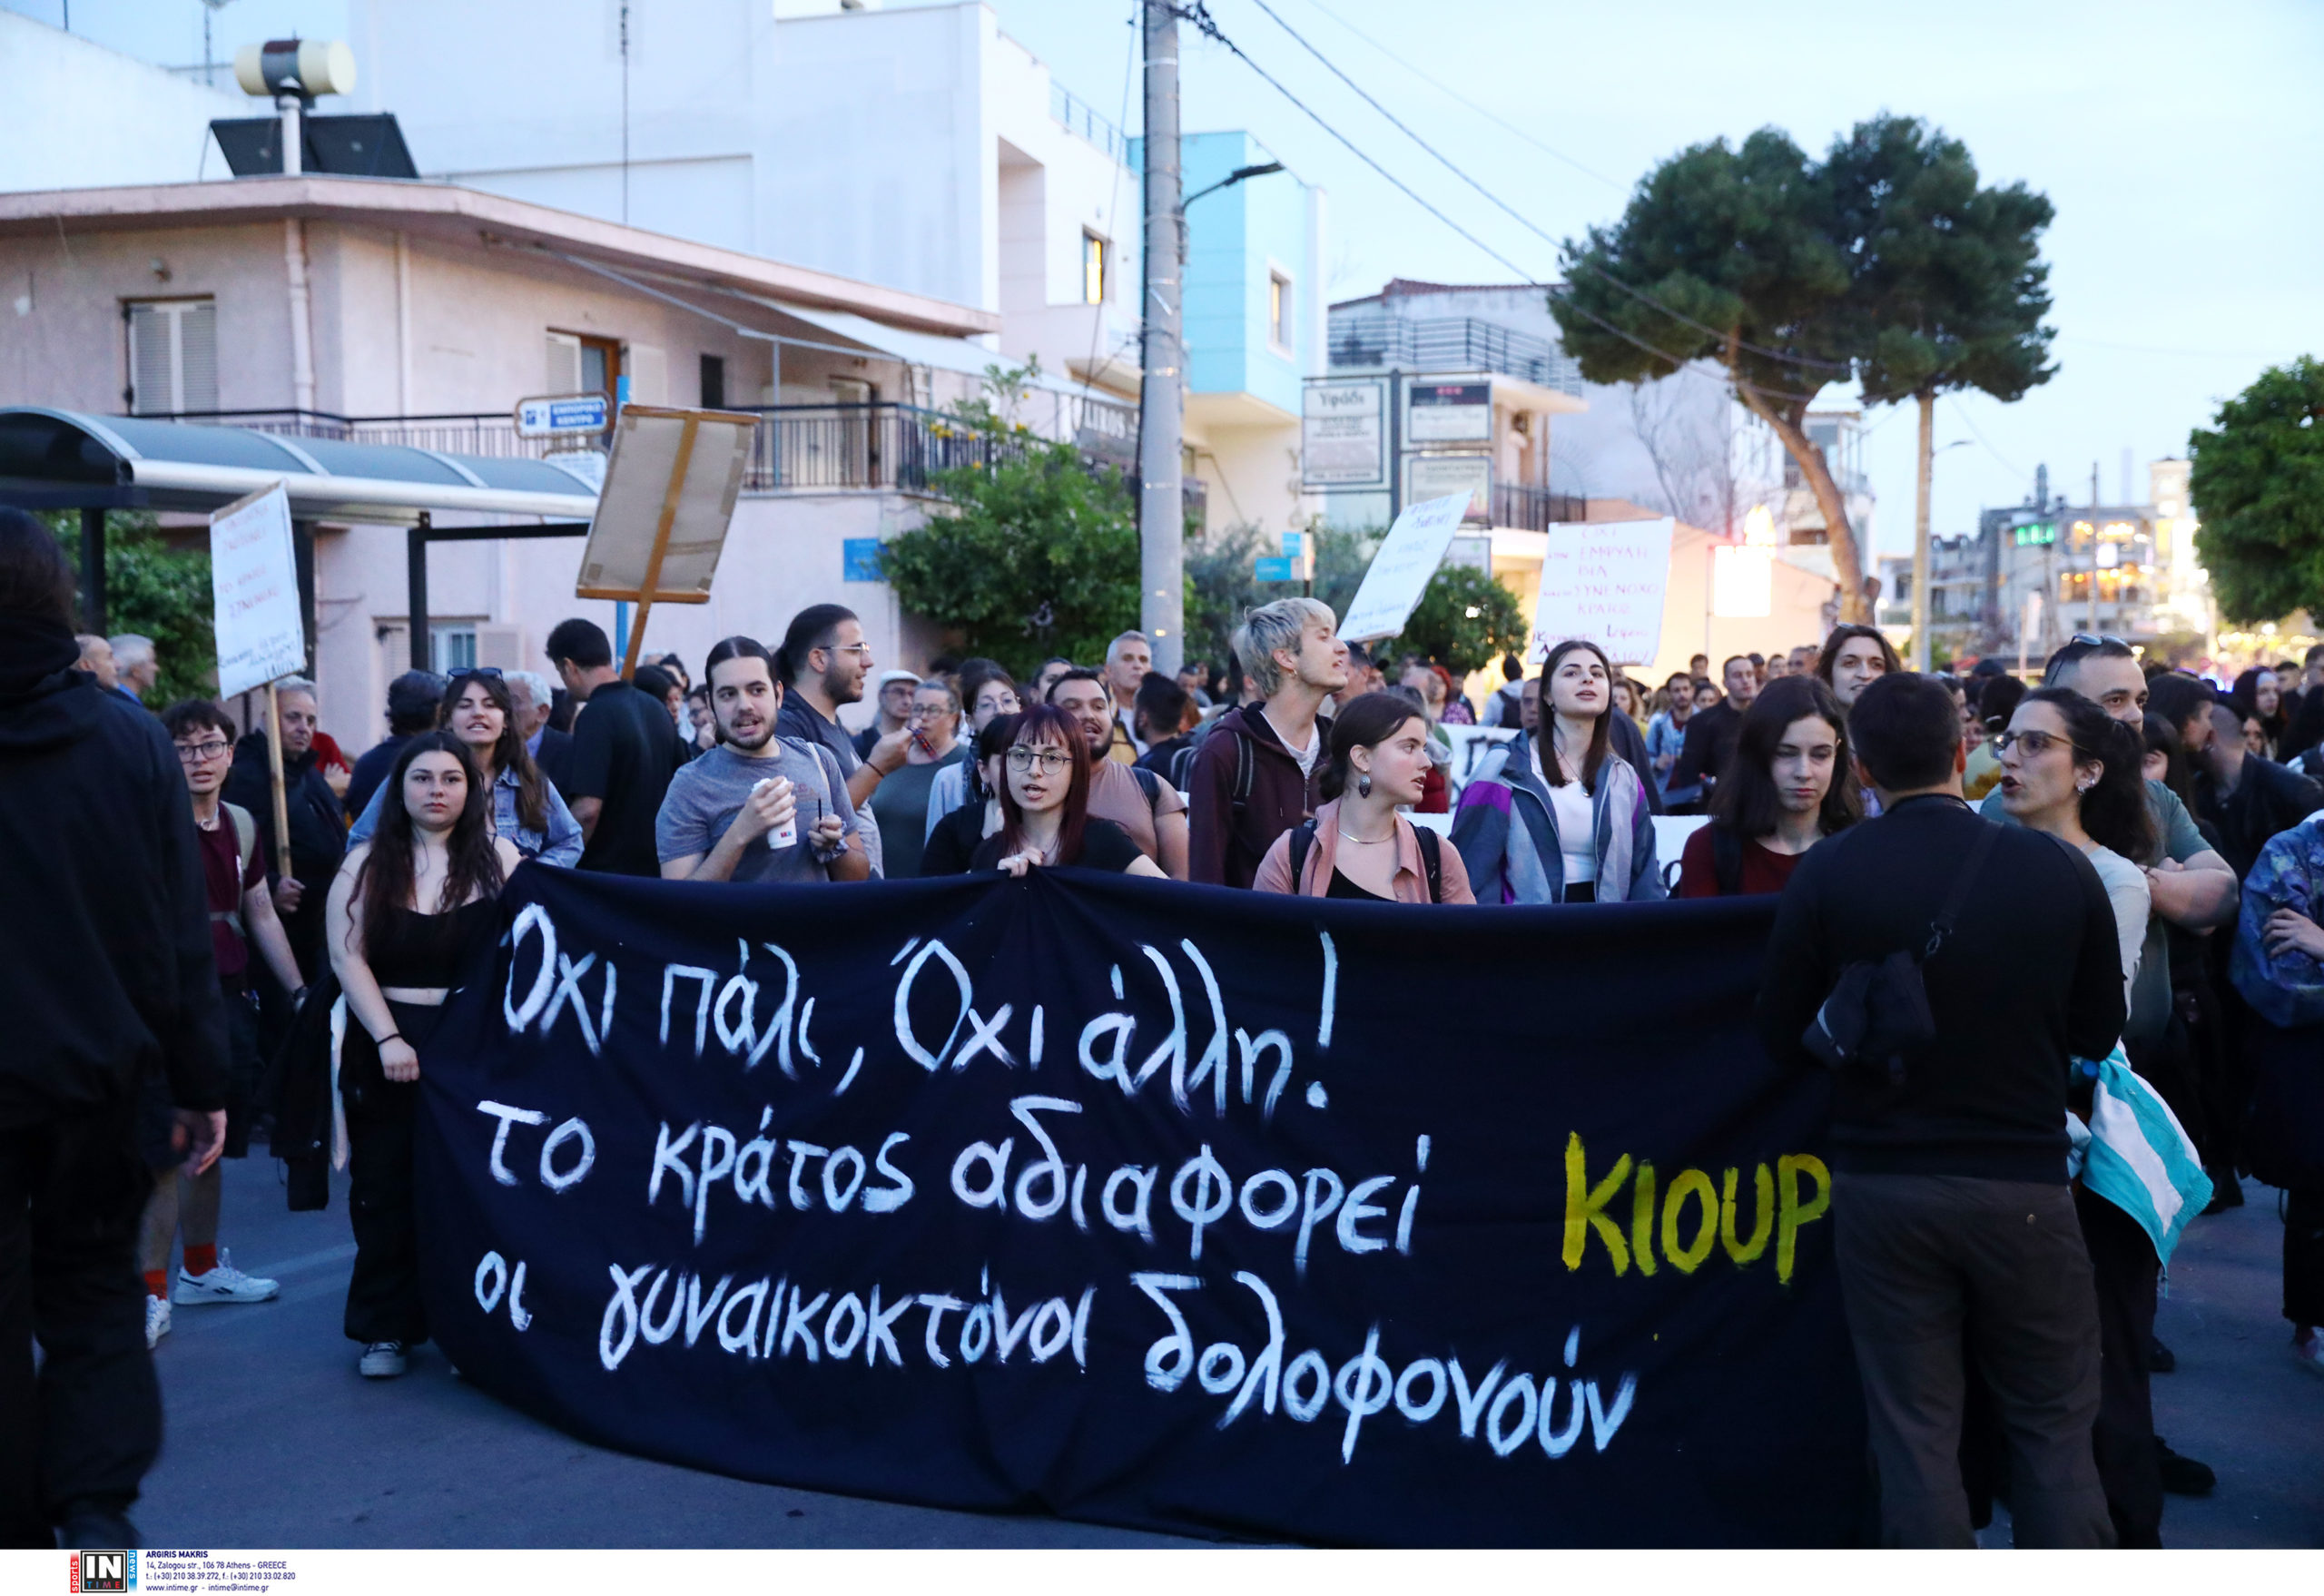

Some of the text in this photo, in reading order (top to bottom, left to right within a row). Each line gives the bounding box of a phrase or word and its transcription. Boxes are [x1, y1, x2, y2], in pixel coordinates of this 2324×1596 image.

[499, 901, 617, 1058] Όχι
[890, 939, 1044, 1072] Όχι
[1070, 933, 1338, 1113] άλλη!
[647, 1104, 915, 1246] κράτος
[951, 1093, 1431, 1270] αδιαφορεί
[475, 1251, 1637, 1463] οι γυναικοκτόνοι δολοφονούν
